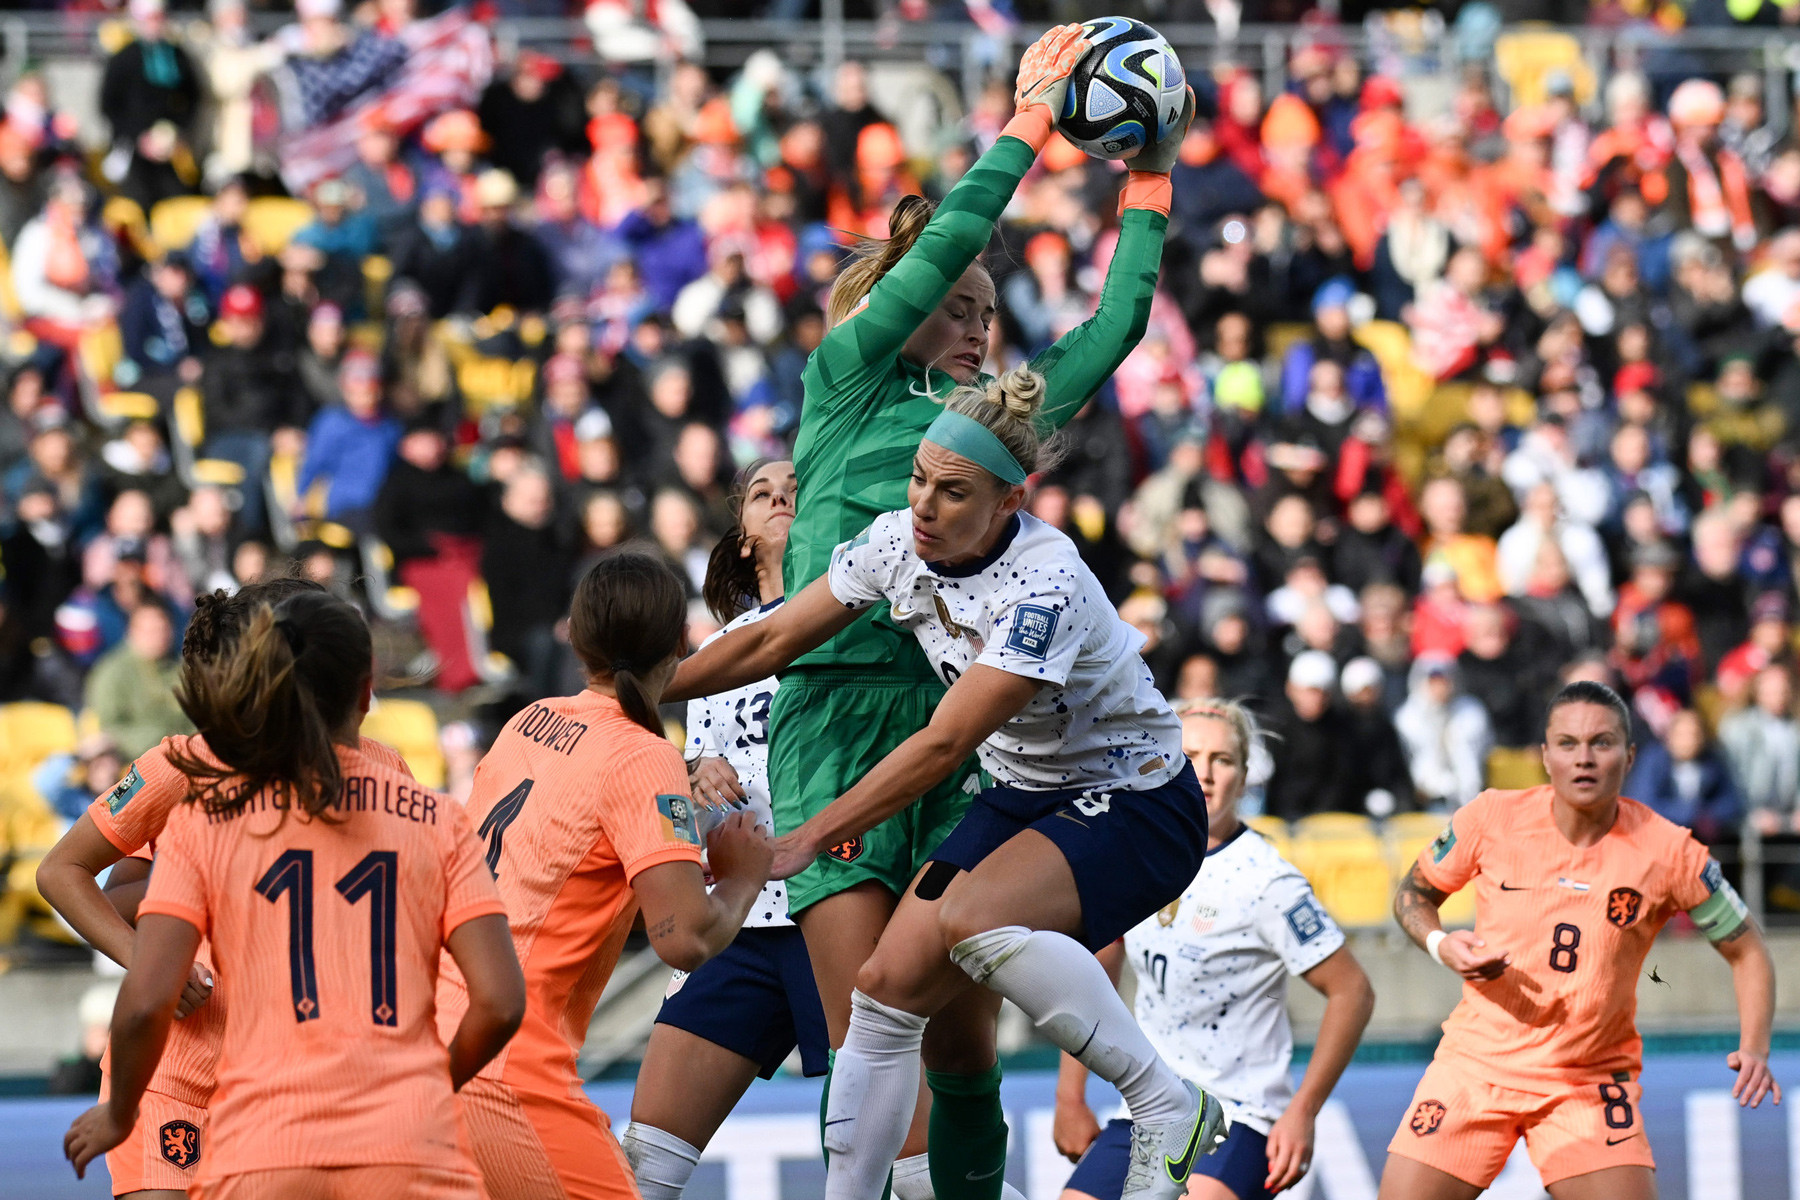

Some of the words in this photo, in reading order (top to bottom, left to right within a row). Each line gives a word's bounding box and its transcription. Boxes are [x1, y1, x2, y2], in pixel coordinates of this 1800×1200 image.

[1018, 626, 1029, 635] the
[1029, 629, 1047, 642] World
[1022, 618, 1048, 633] UNITES
[1023, 611, 1049, 624] FOOTBALL
[1024, 638, 1036, 646] FIFA
[513, 703, 588, 756] NOUWEN
[735, 691, 773, 748] 13
[384, 780, 437, 825] LEER
[253, 848, 399, 1027] 11
[1549, 922, 1582, 974] 8
[1142, 948, 1168, 996] 10
[1599, 1083, 1634, 1129] 8
